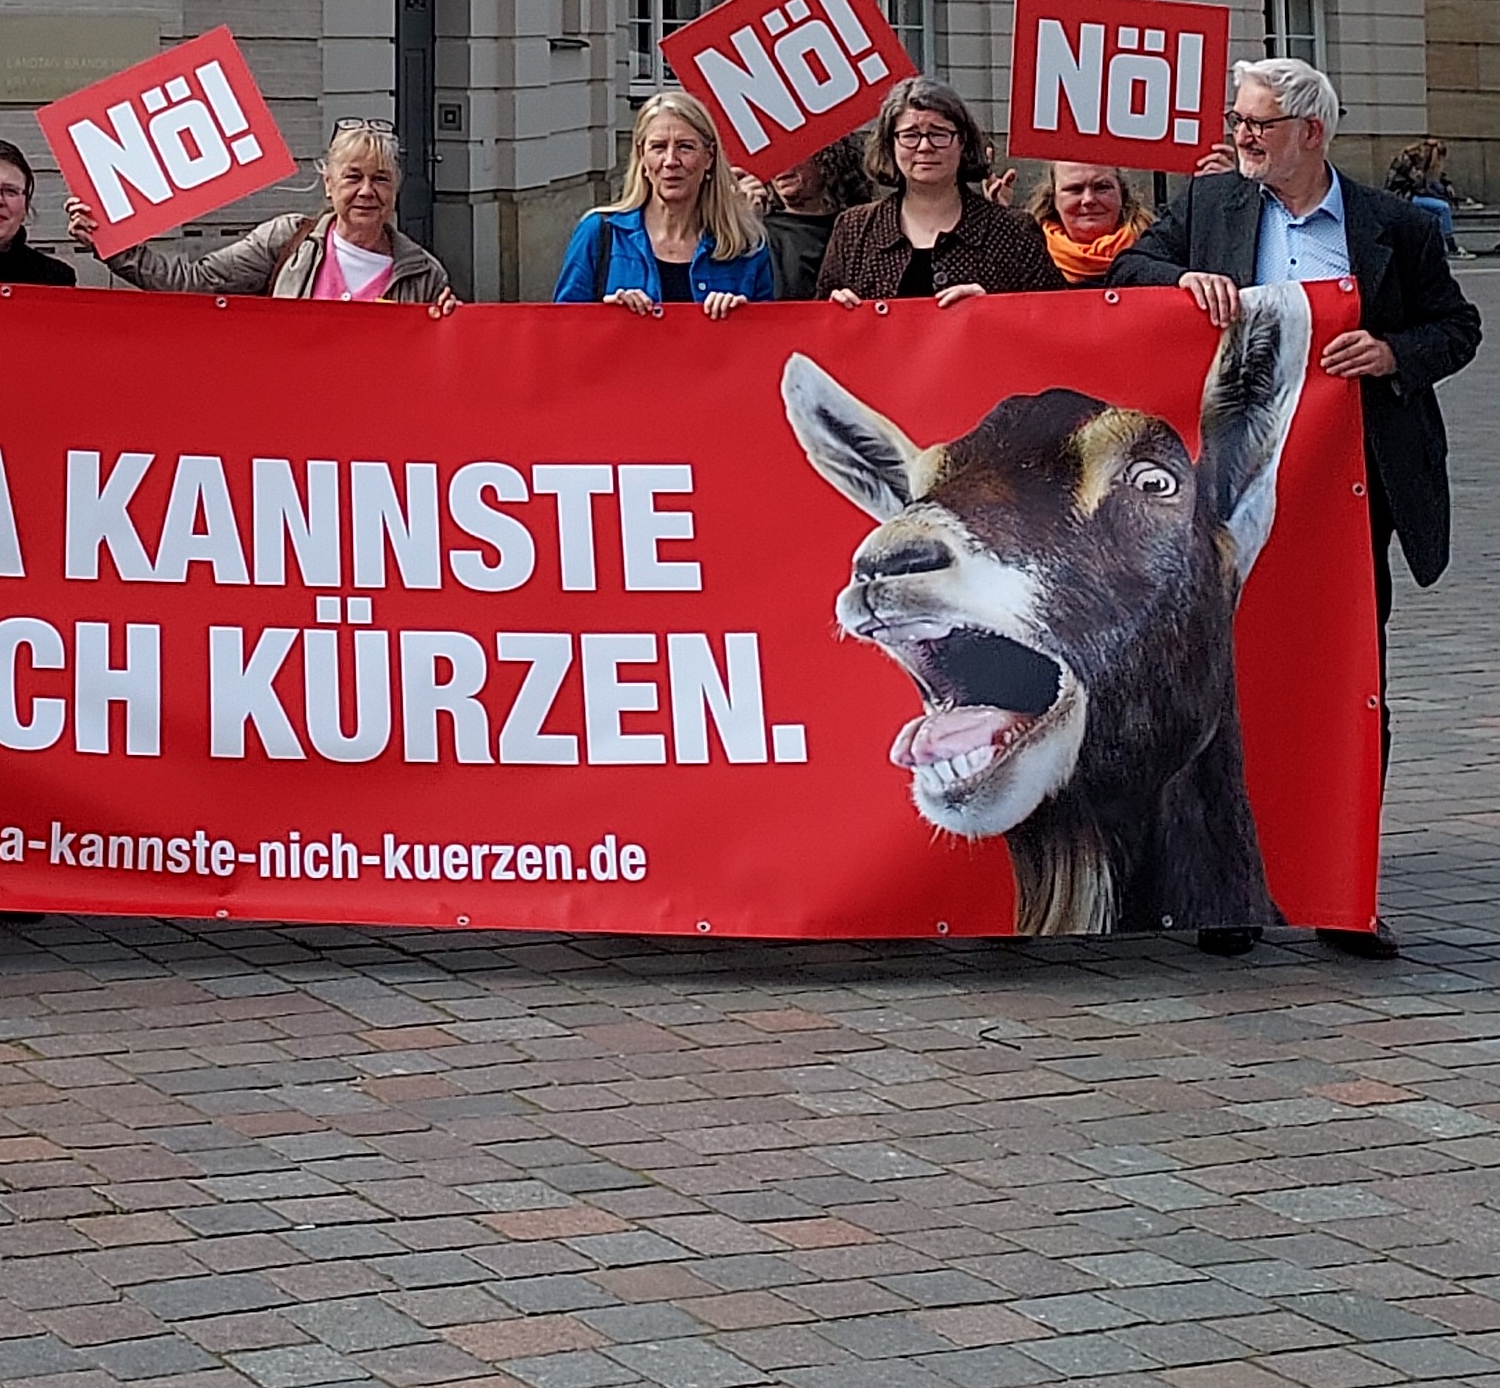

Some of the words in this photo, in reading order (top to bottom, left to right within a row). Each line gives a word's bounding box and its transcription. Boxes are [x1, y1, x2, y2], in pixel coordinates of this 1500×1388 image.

[67, 59, 264, 224] NÖ!
[1032, 18, 1205, 146] NÖ!
[64, 449, 703, 593] KANNSTE
[208, 594, 808, 766] KÜRZEN.
